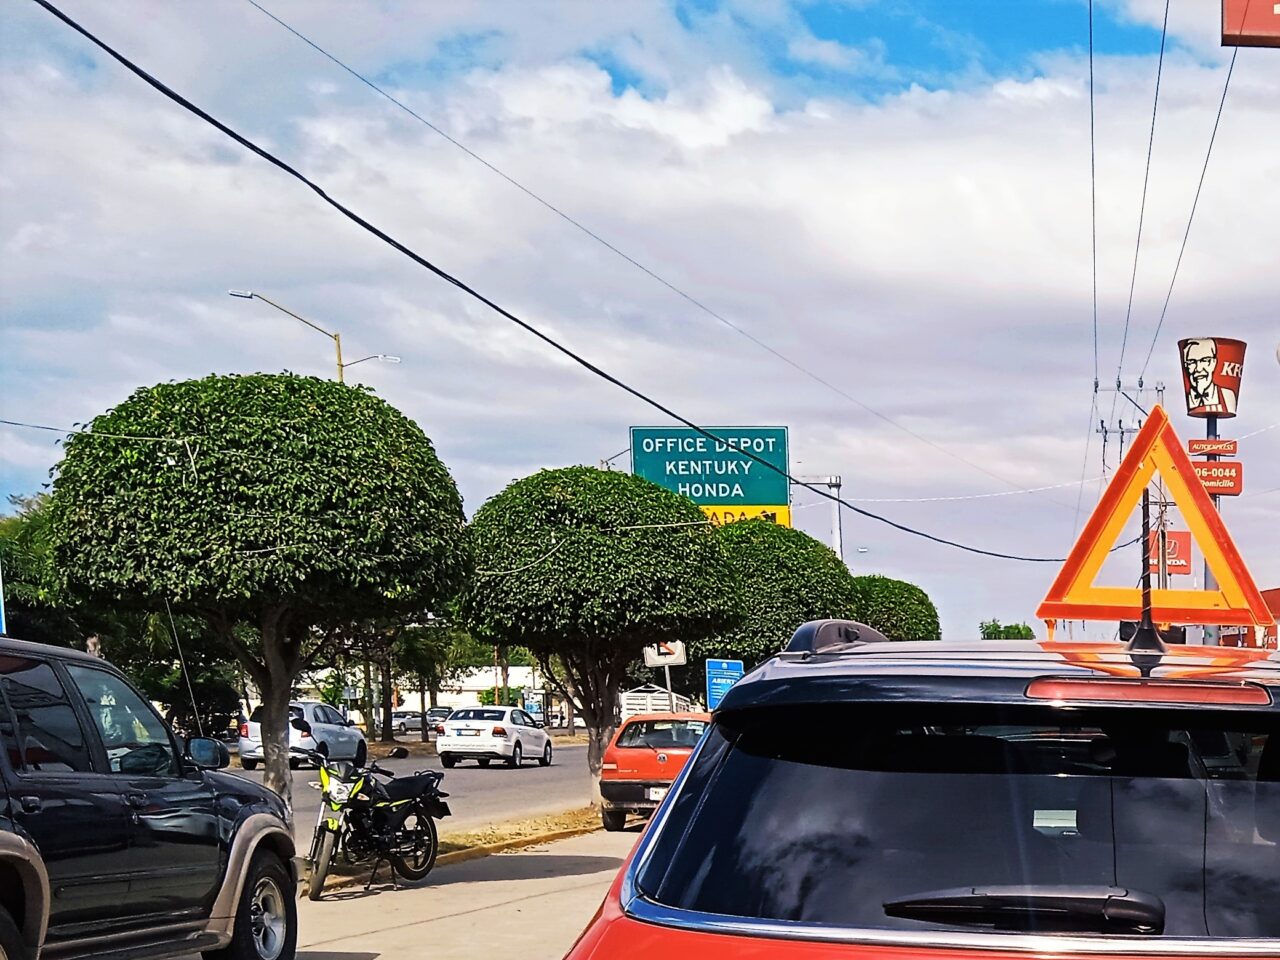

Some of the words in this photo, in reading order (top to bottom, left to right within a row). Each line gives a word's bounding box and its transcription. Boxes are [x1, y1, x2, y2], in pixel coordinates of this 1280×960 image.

[642, 438, 707, 452] OFFICE
[715, 438, 776, 452] DEPOT
[665, 461, 752, 475] KENTUKY
[1195, 467, 1237, 477] 06-0044
[678, 483, 744, 498] HONDA
